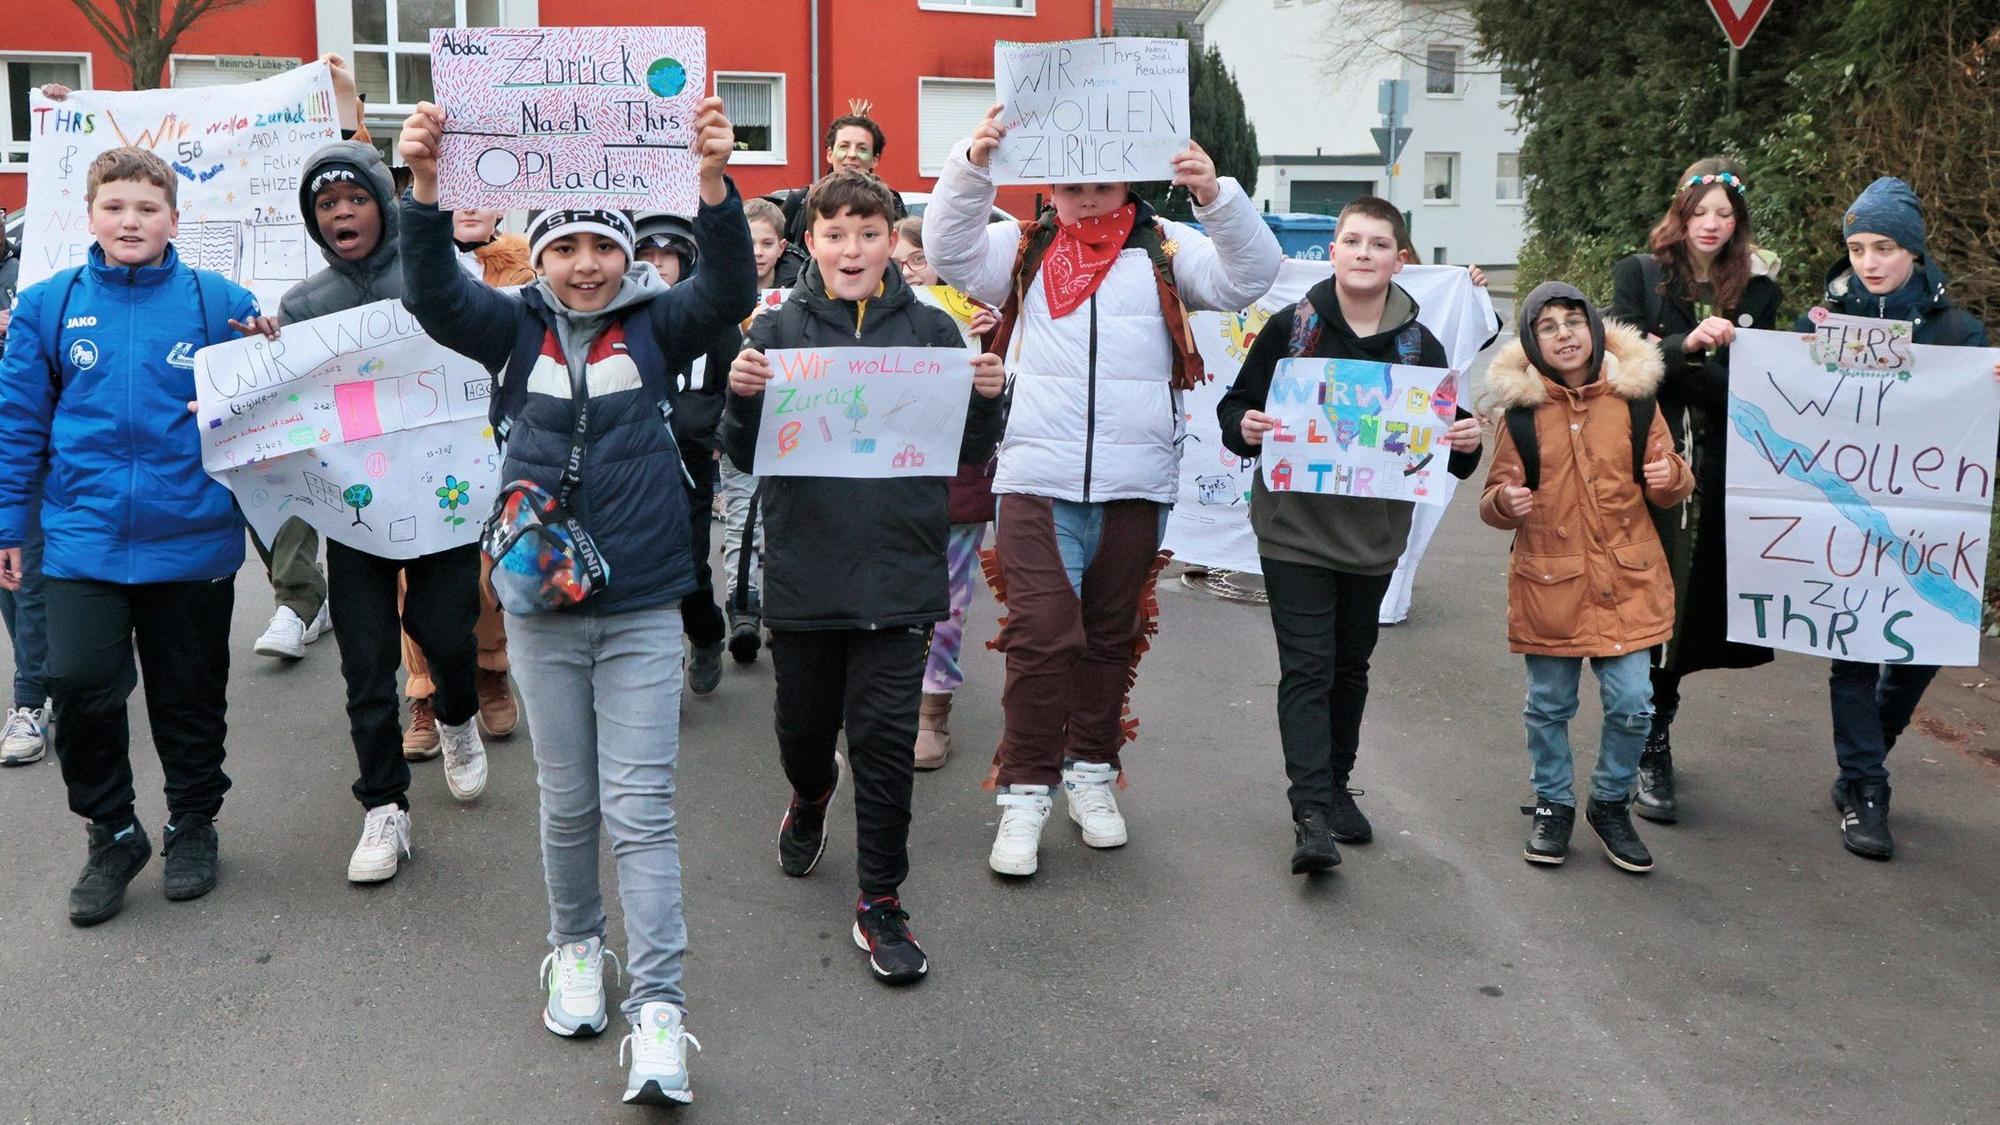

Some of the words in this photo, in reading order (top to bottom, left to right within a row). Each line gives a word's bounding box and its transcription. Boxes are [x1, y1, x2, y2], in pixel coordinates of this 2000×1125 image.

[440, 33, 488, 55] Abdou
[1003, 48, 1075, 94] WIR
[33, 107, 95, 135] THRS
[522, 101, 589, 134] Nach
[614, 101, 680, 132] Thrs
[1014, 90, 1176, 134] WOLLEN
[1017, 133, 1138, 178] ZURÜCK
[66, 316, 97, 329] JAKO
[1817, 325, 1904, 369] THRS
[566, 518, 602, 578] UNDER
